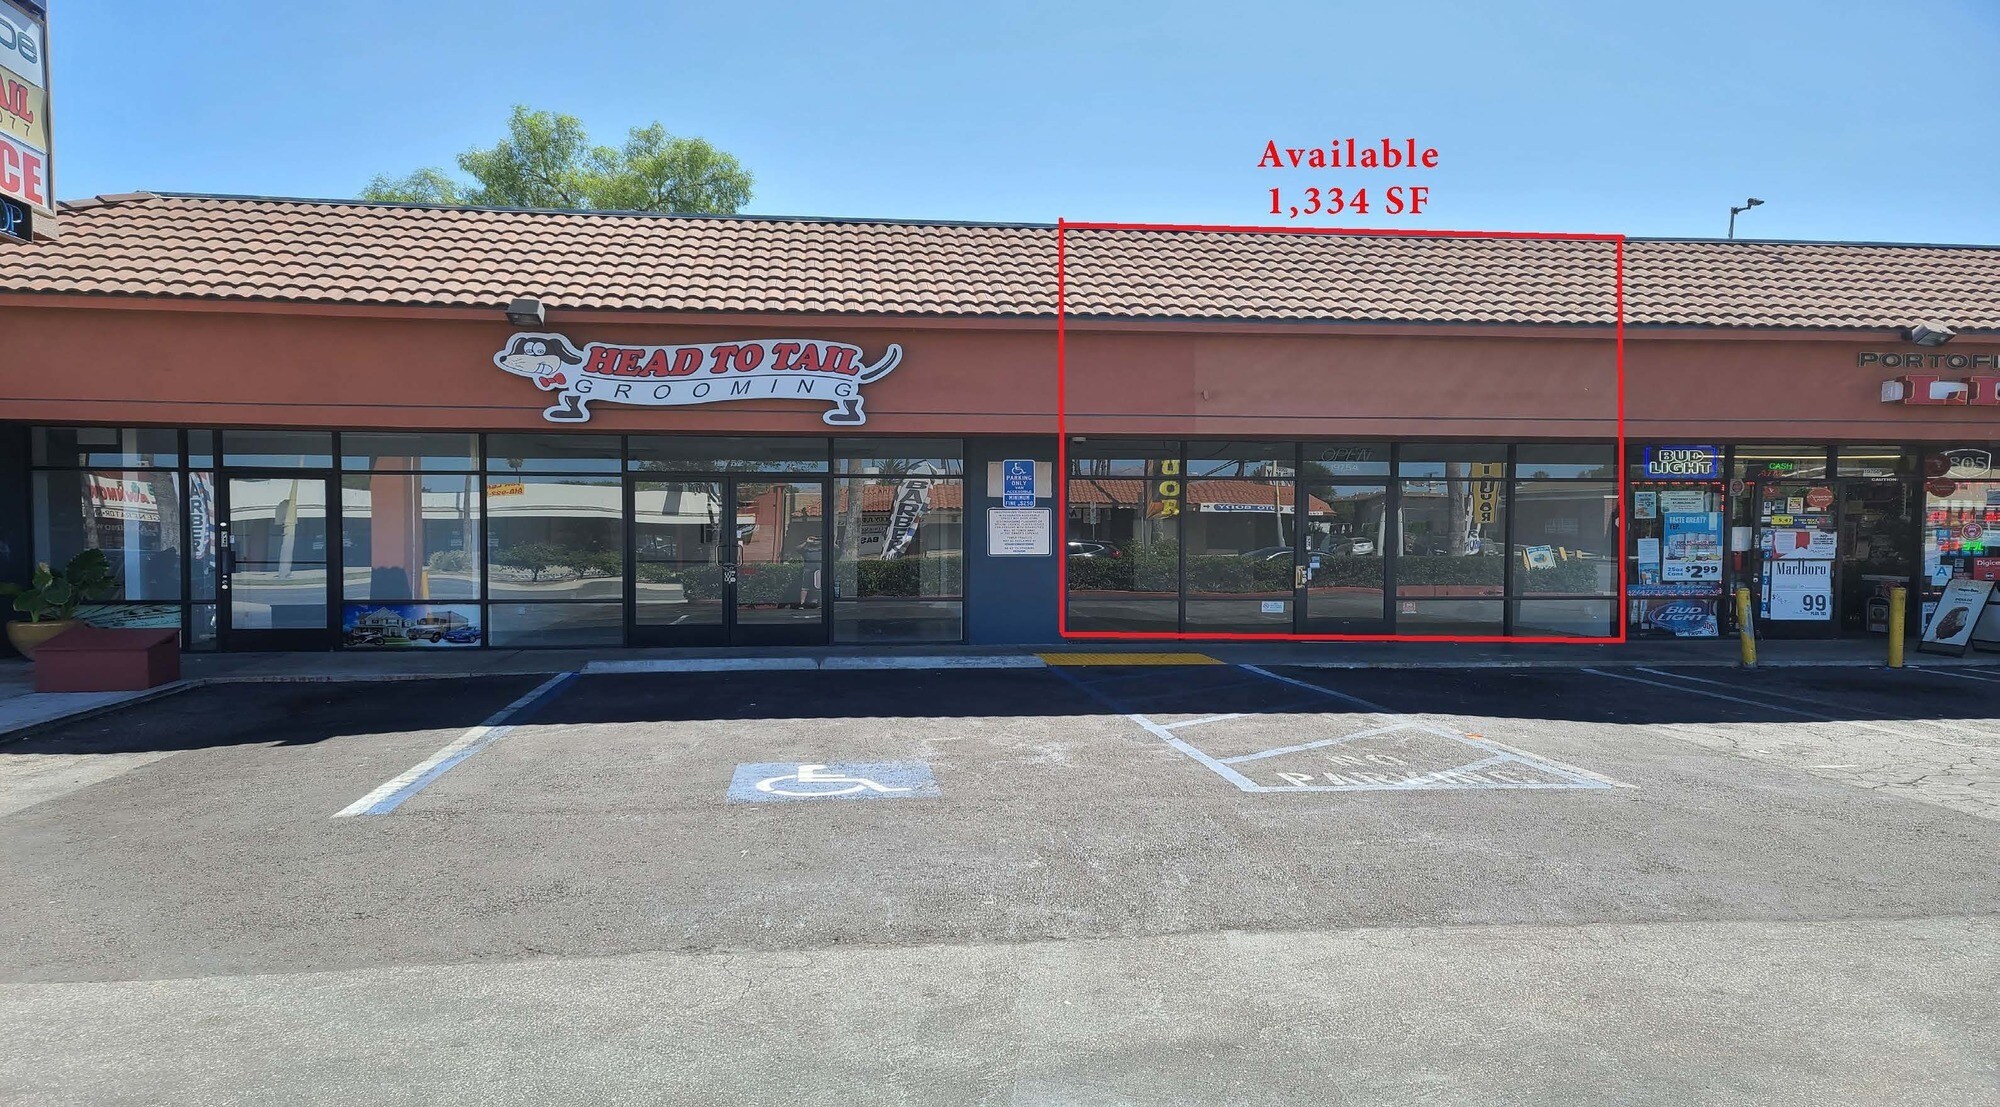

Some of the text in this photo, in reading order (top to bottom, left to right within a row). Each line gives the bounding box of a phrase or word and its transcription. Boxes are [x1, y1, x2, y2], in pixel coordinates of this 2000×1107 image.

[583, 342, 861, 378] HEAD TO TAIL
[574, 378, 852, 400] GROOMING
[1321, 448, 1373, 462] OPEN
[1659, 449, 1704, 463] BUD
[1649, 461, 1712, 474] LIGHT
[1769, 462, 1793, 470] CASH
[1950, 456, 1988, 469] 805
[1776, 561, 1827, 576] Marlboro
[1936, 566, 1947, 576] A
[1803, 595, 1827, 611] 99
